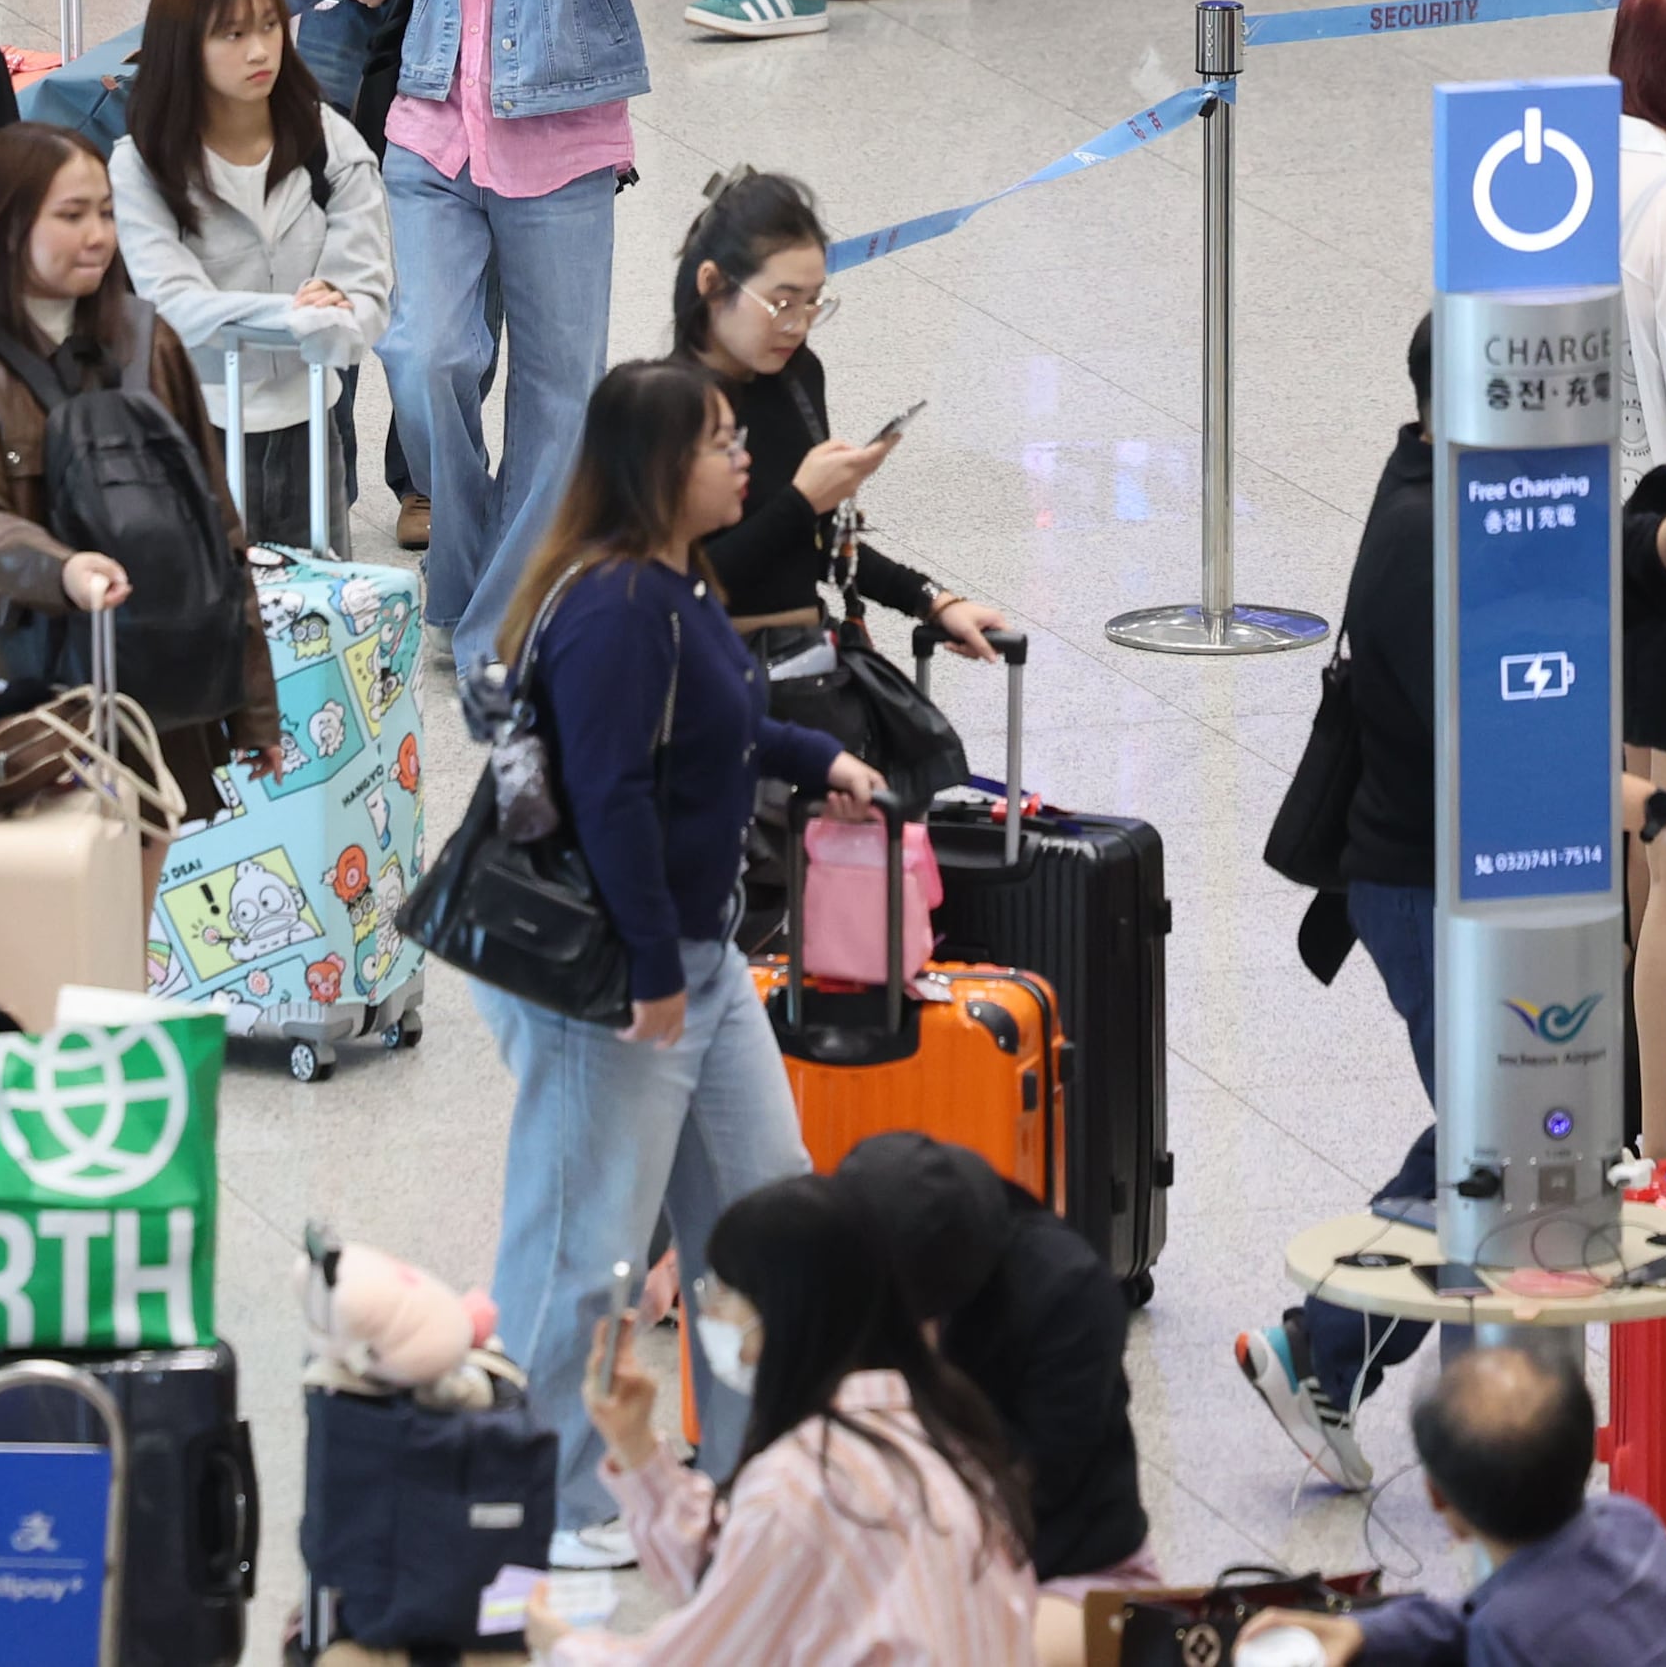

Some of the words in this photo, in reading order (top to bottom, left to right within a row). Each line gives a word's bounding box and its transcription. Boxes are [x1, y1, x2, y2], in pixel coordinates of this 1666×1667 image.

[1485, 329, 1611, 366] CHARGE
[1468, 481, 1507, 502] Free
[1509, 473, 1590, 500] Charging
[1497, 1053, 1558, 1066] Incheon
[1564, 1048, 1606, 1065] Airport
